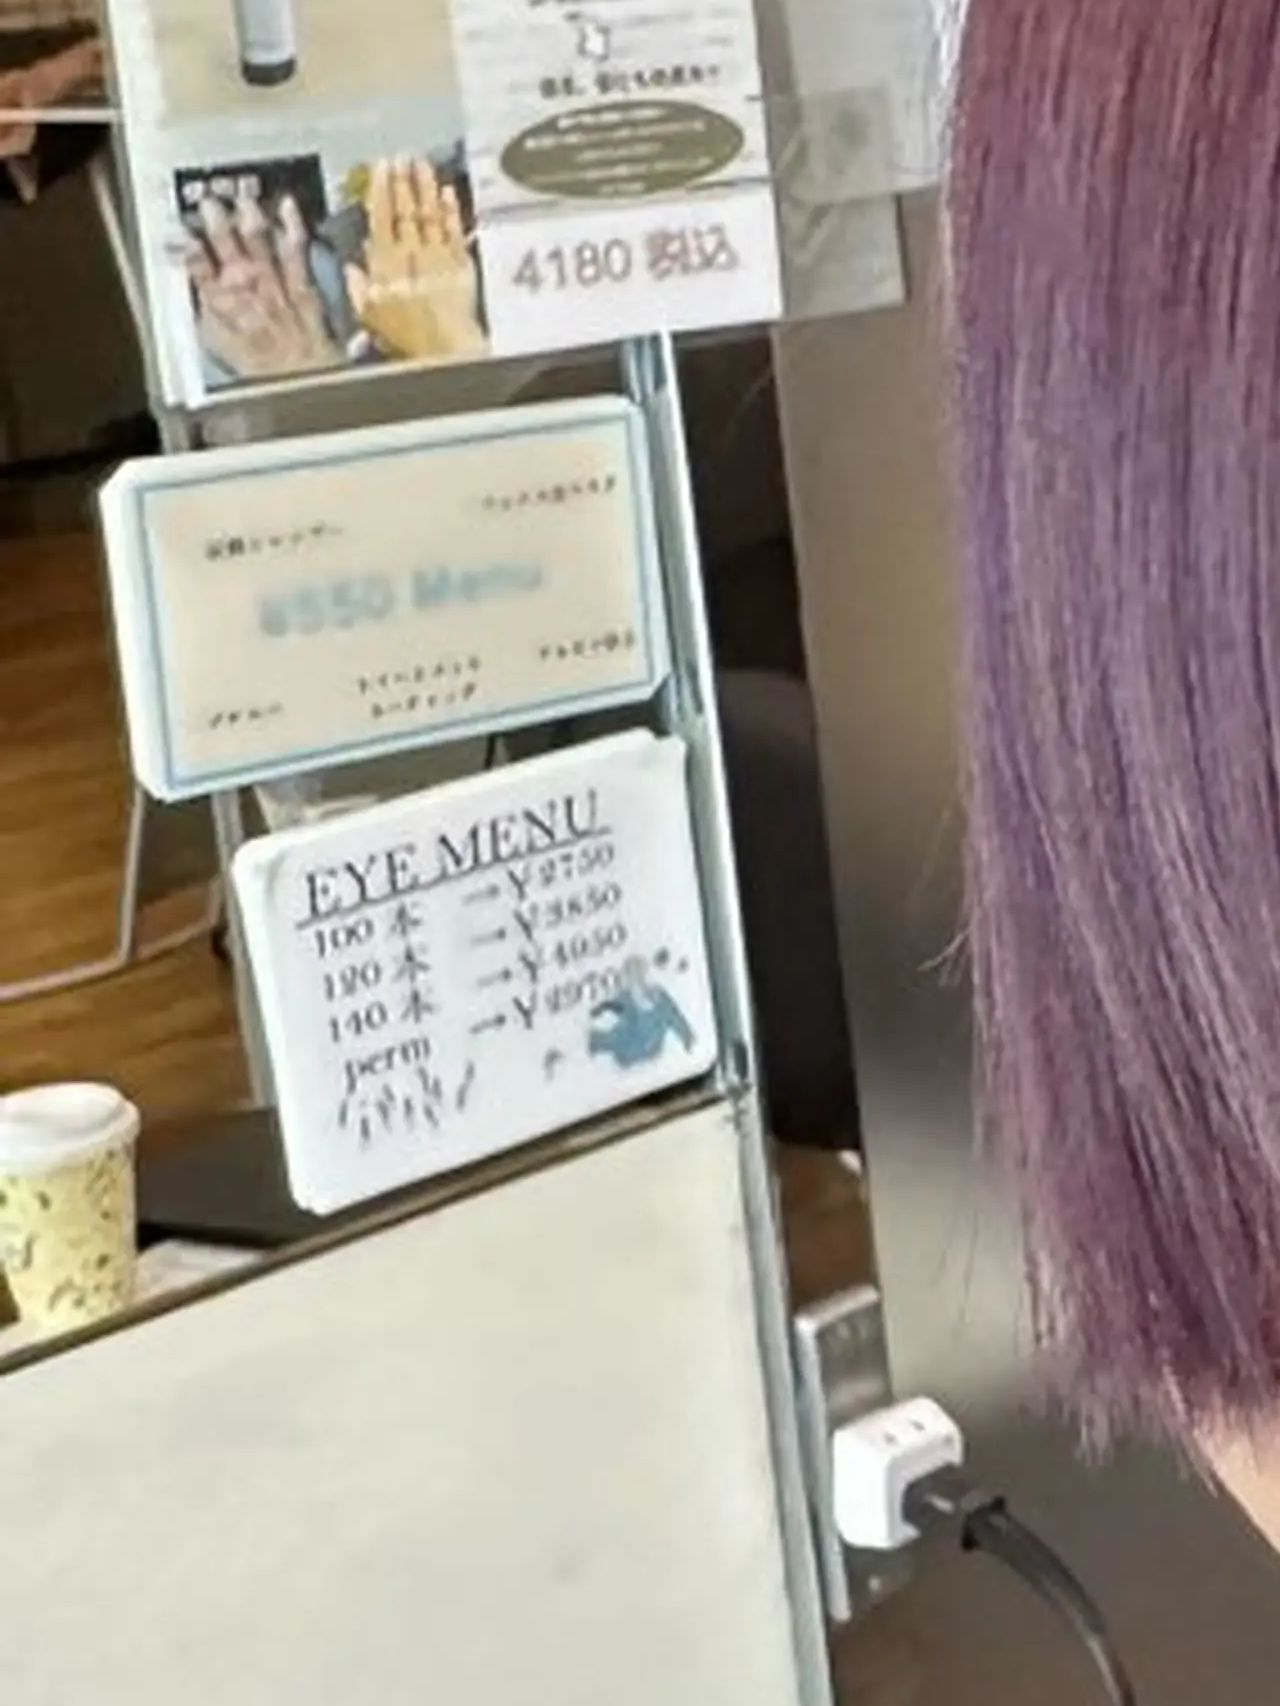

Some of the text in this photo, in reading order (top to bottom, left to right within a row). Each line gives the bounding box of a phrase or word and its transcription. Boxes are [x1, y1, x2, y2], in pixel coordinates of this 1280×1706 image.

[512, 237, 633, 294] 4180
[306, 787, 600, 919] EYE MENU
[314, 916, 374, 959] 100
[323, 959, 383, 1002] 120
[344, 1035, 431, 1096] perm
